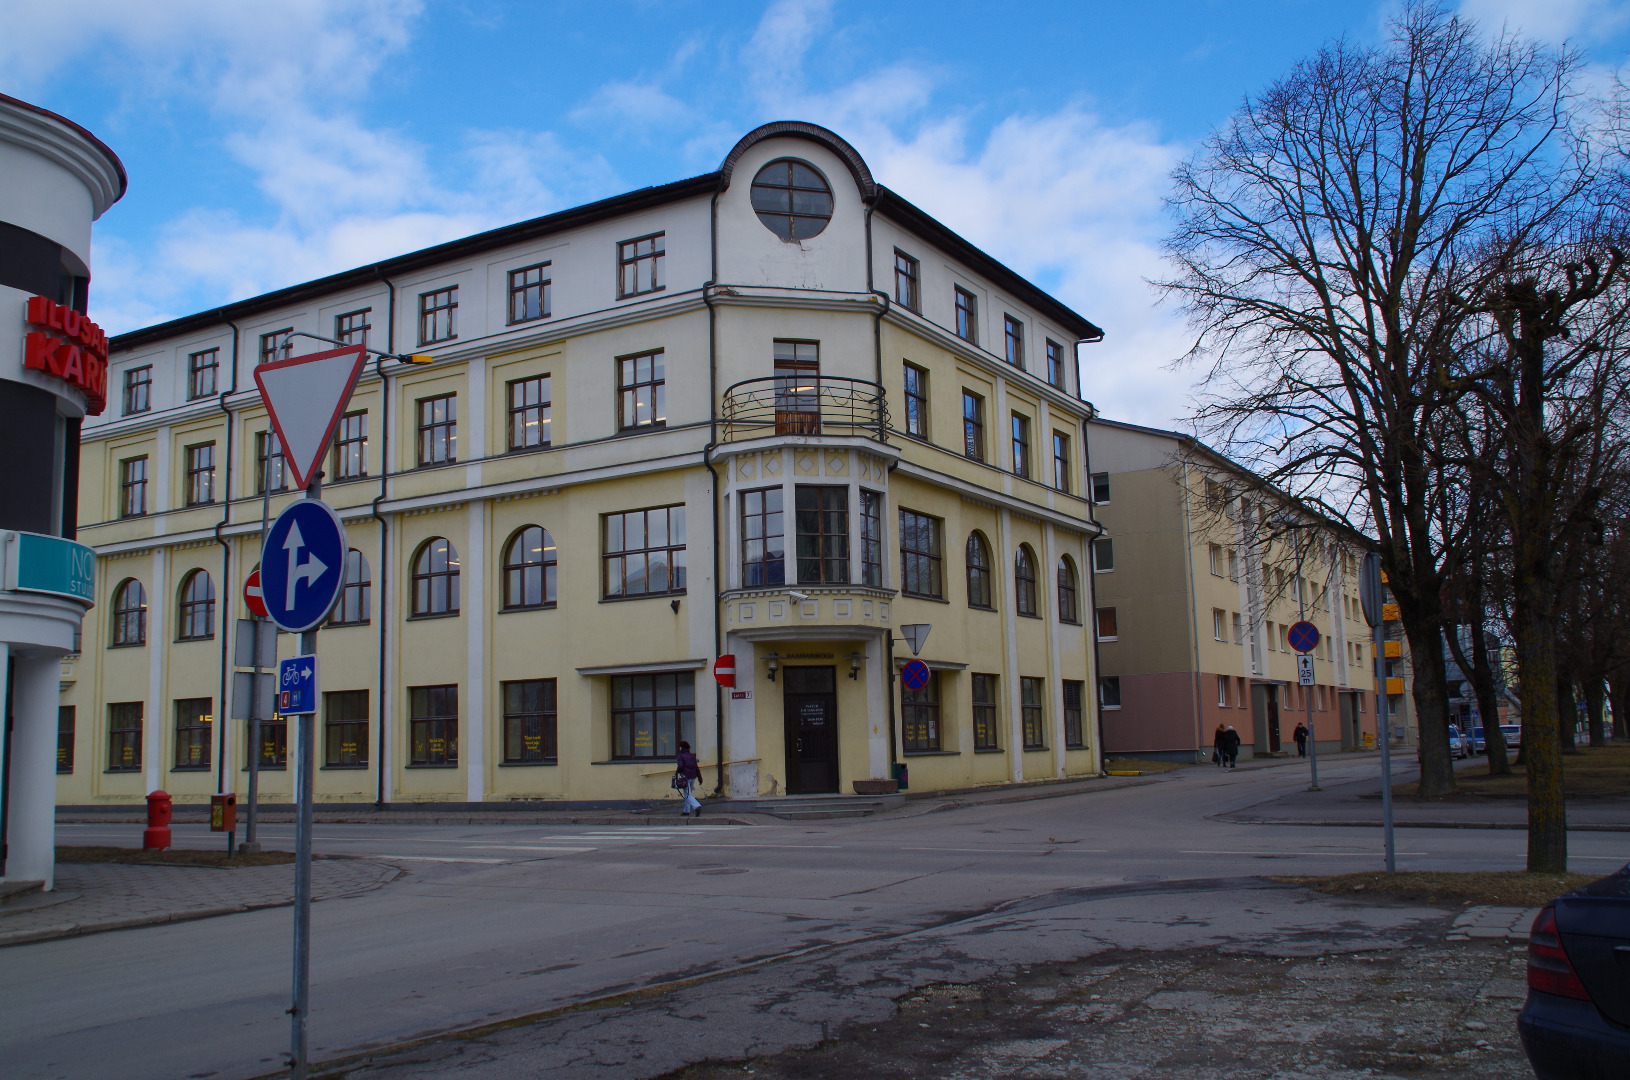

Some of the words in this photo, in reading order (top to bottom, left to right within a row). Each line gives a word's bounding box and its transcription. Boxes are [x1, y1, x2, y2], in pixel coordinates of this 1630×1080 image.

[27, 295, 108, 365] ILUSAL
[1301, 669, 1312, 678] 25
[283, 694, 288, 705] 4
